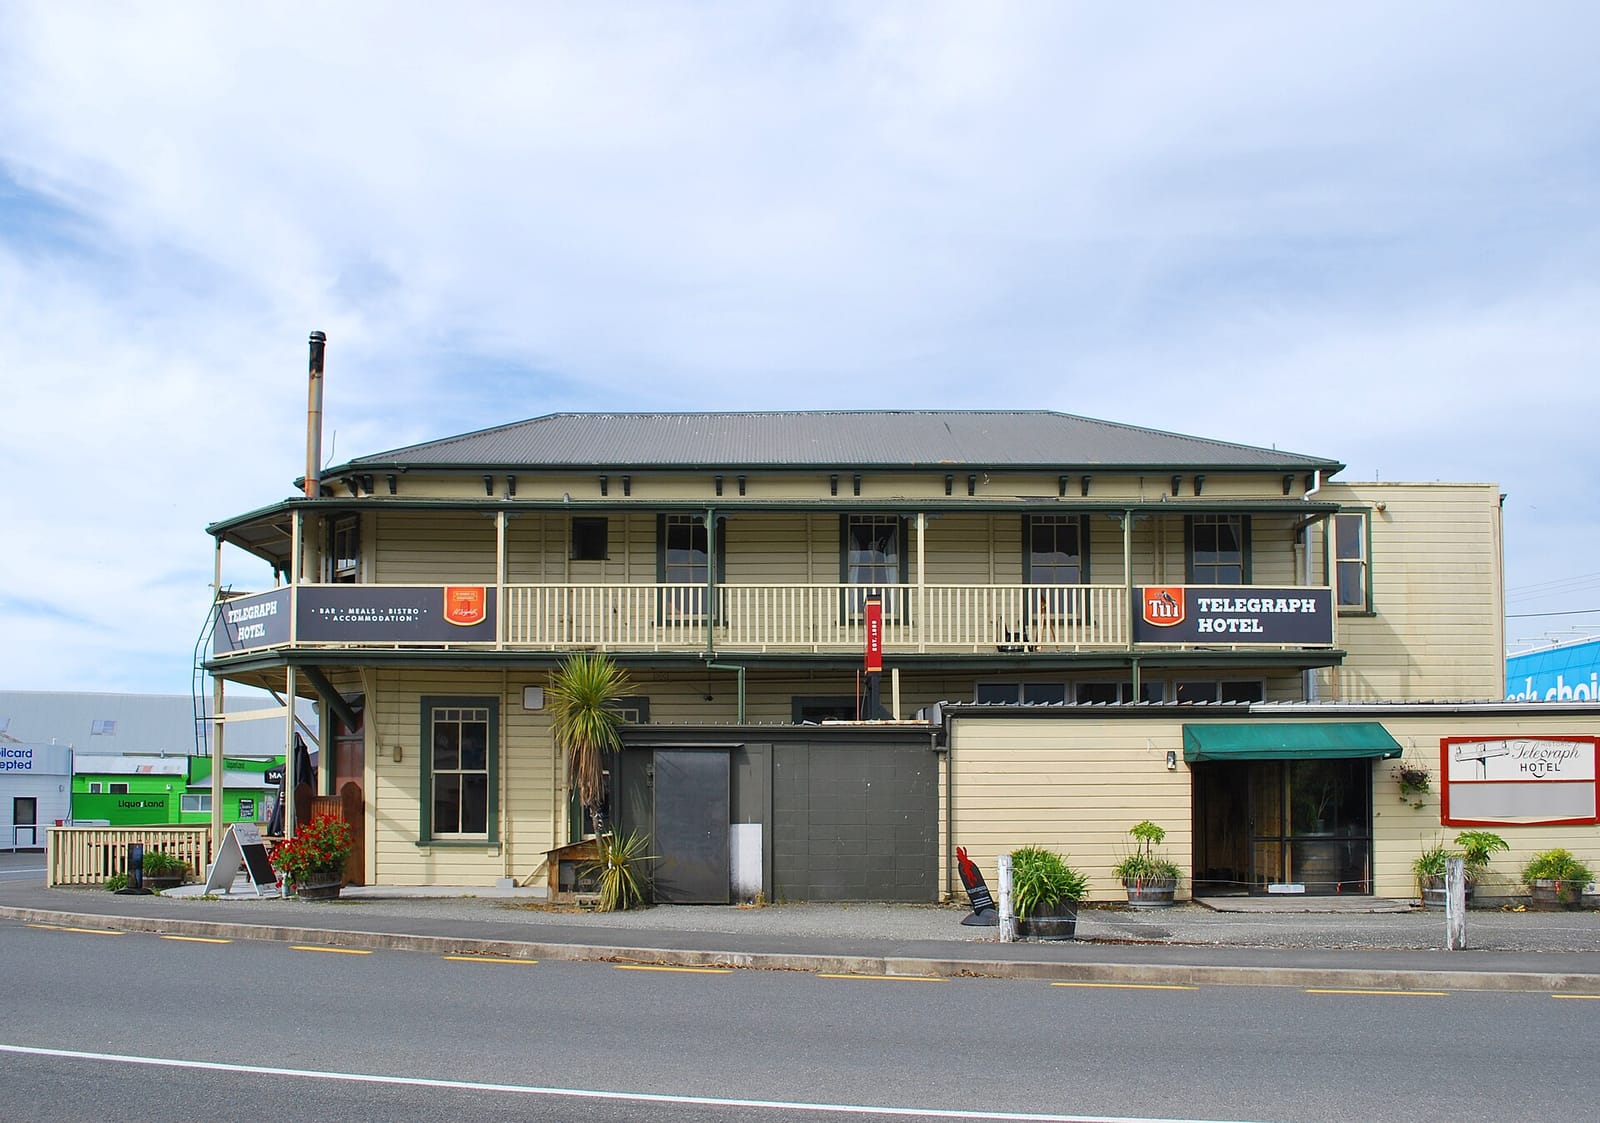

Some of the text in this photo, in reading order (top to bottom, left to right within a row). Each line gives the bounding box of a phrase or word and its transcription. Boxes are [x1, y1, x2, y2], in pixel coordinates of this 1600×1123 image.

[228, 600, 278, 624] TELEGRAPH
[319, 607, 420, 615] BAR MEALS BISTRO
[1149, 600, 1179, 617] Tui
[1197, 598, 1316, 613] TELEGRAPH
[238, 623, 266, 641] HOTEL
[1197, 618, 1264, 633] HOTEL
[1545, 672, 1600, 702] choi
[0, 747, 33, 758] ilcard
[1512, 740, 1580, 765] Telegraph
[1520, 763, 1561, 772] HOTEL
